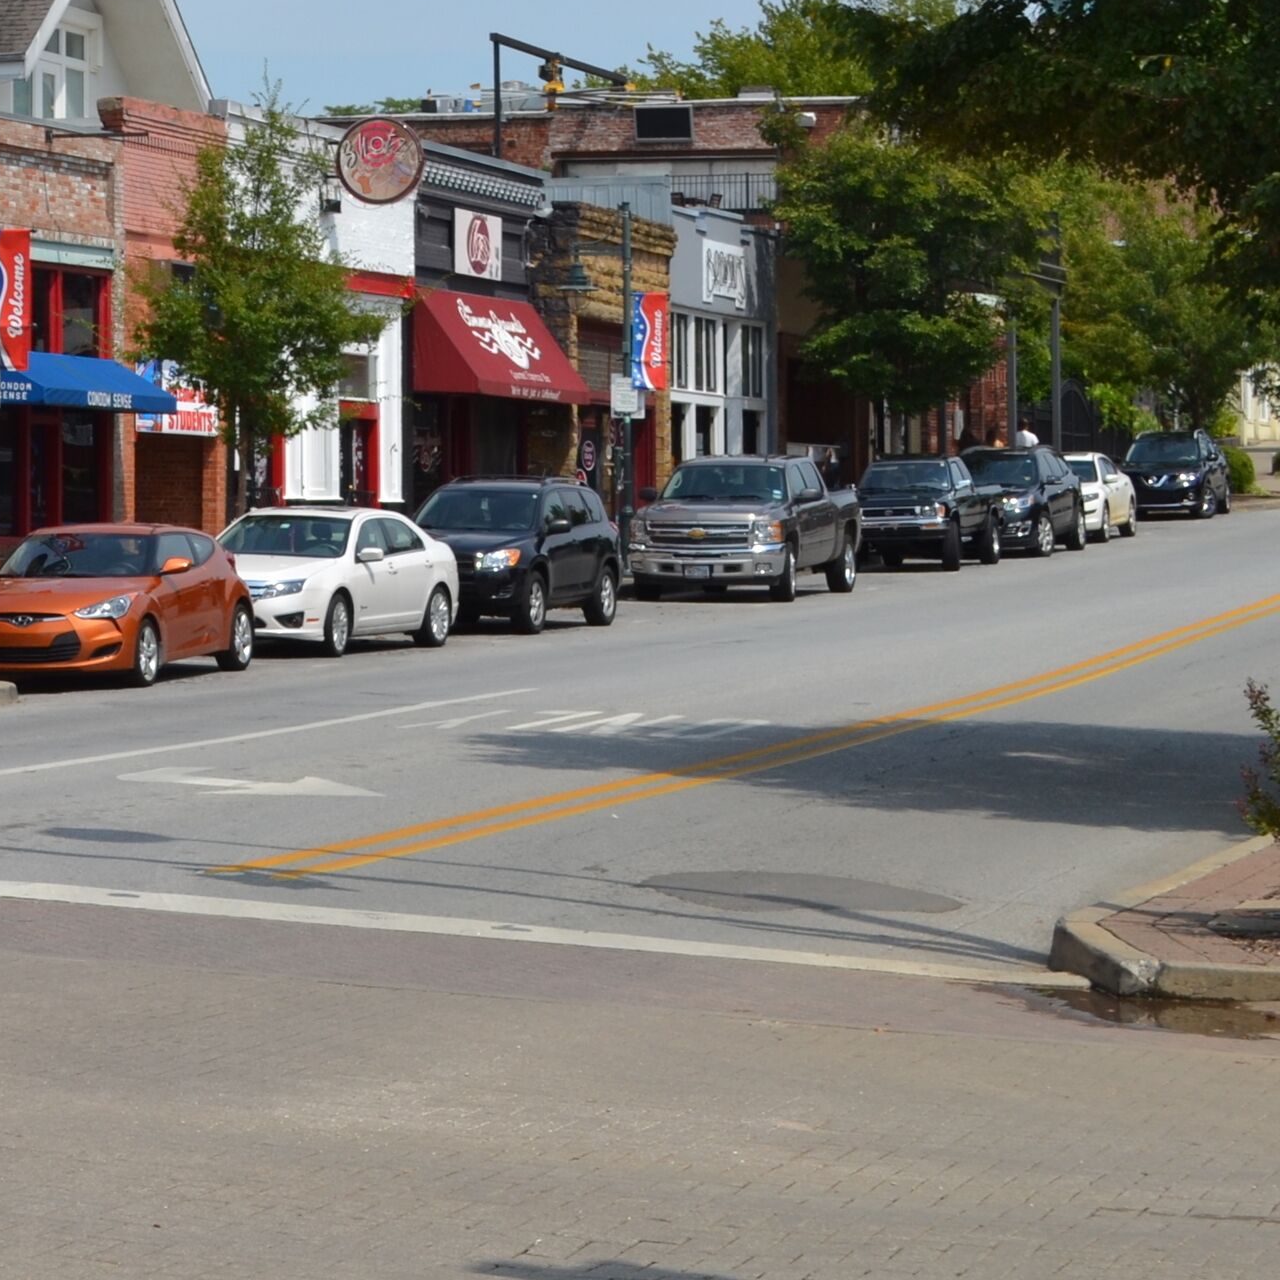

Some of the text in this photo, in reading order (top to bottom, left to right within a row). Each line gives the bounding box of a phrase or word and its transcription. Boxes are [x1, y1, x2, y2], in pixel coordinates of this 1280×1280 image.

[6, 253, 25, 338] Welcome
[650, 309, 663, 368] Welcome
[0, 381, 32, 391] ONDOM
[87, 391, 132, 409] CONDOM SENSE
[168, 410, 213, 432] STUDENTS
